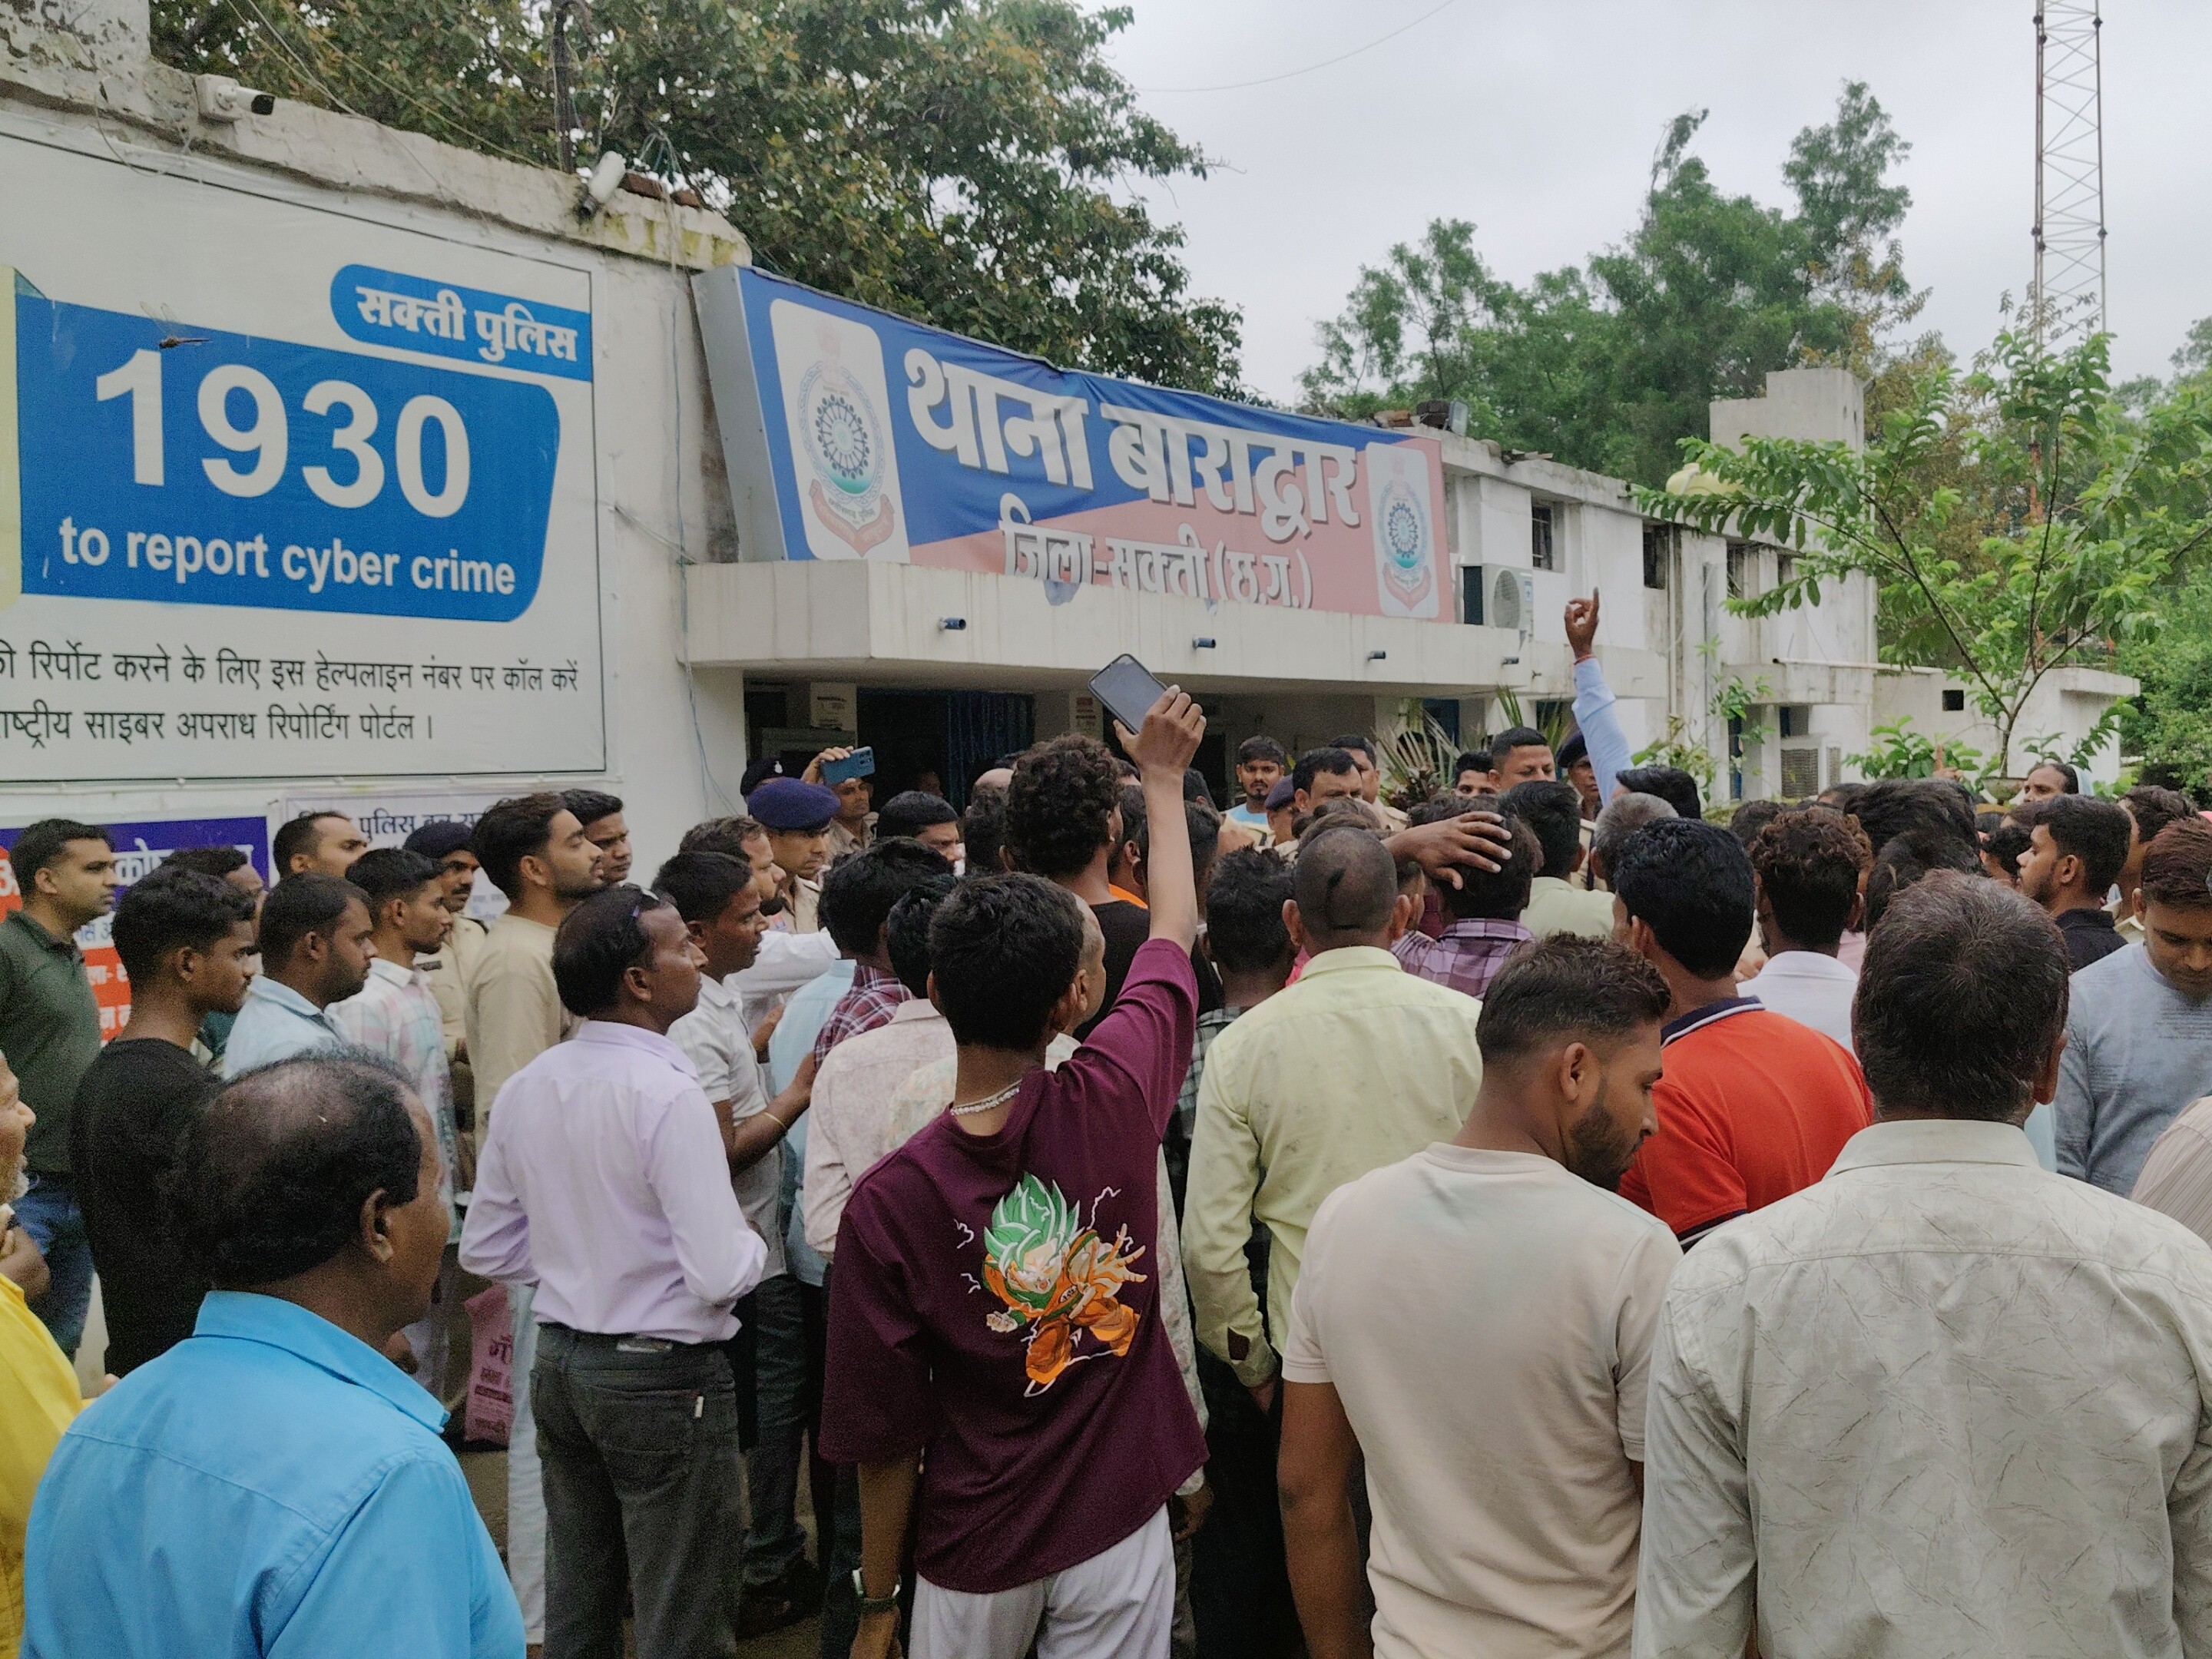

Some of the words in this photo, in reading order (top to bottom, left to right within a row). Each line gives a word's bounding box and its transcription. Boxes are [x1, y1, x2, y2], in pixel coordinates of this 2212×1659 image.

[356, 286, 466, 341] सक्ती
[474, 302, 578, 363] पुलिस
[96, 348, 470, 518] 1930
[904, 348, 1094, 492] थाना
[1100, 402, 1361, 542] बाराद्वार
[59, 515, 110, 565] to
[127, 534, 270, 584] report
[282, 538, 400, 594] cyber
[411, 548, 516, 594] crime
[113, 643, 171, 682] करने
[181, 644, 206, 683] के
[216, 647, 261, 690] लिए
[270, 660, 305, 690] इस
[314, 650, 413, 693] हेल्पलाइन
[422, 654, 462, 690] नंबर
[469, 666, 495, 690] पर
[502, 657, 544, 691] कॉल
[550, 658, 578, 691] करें
[84, 712, 165, 744] साइबर
[177, 712, 257, 739] अपराध
[267, 702, 350, 739] रिपोर्टिंग
[359, 704, 415, 739] पोर्टल
[359, 807, 417, 843] पुलिस
